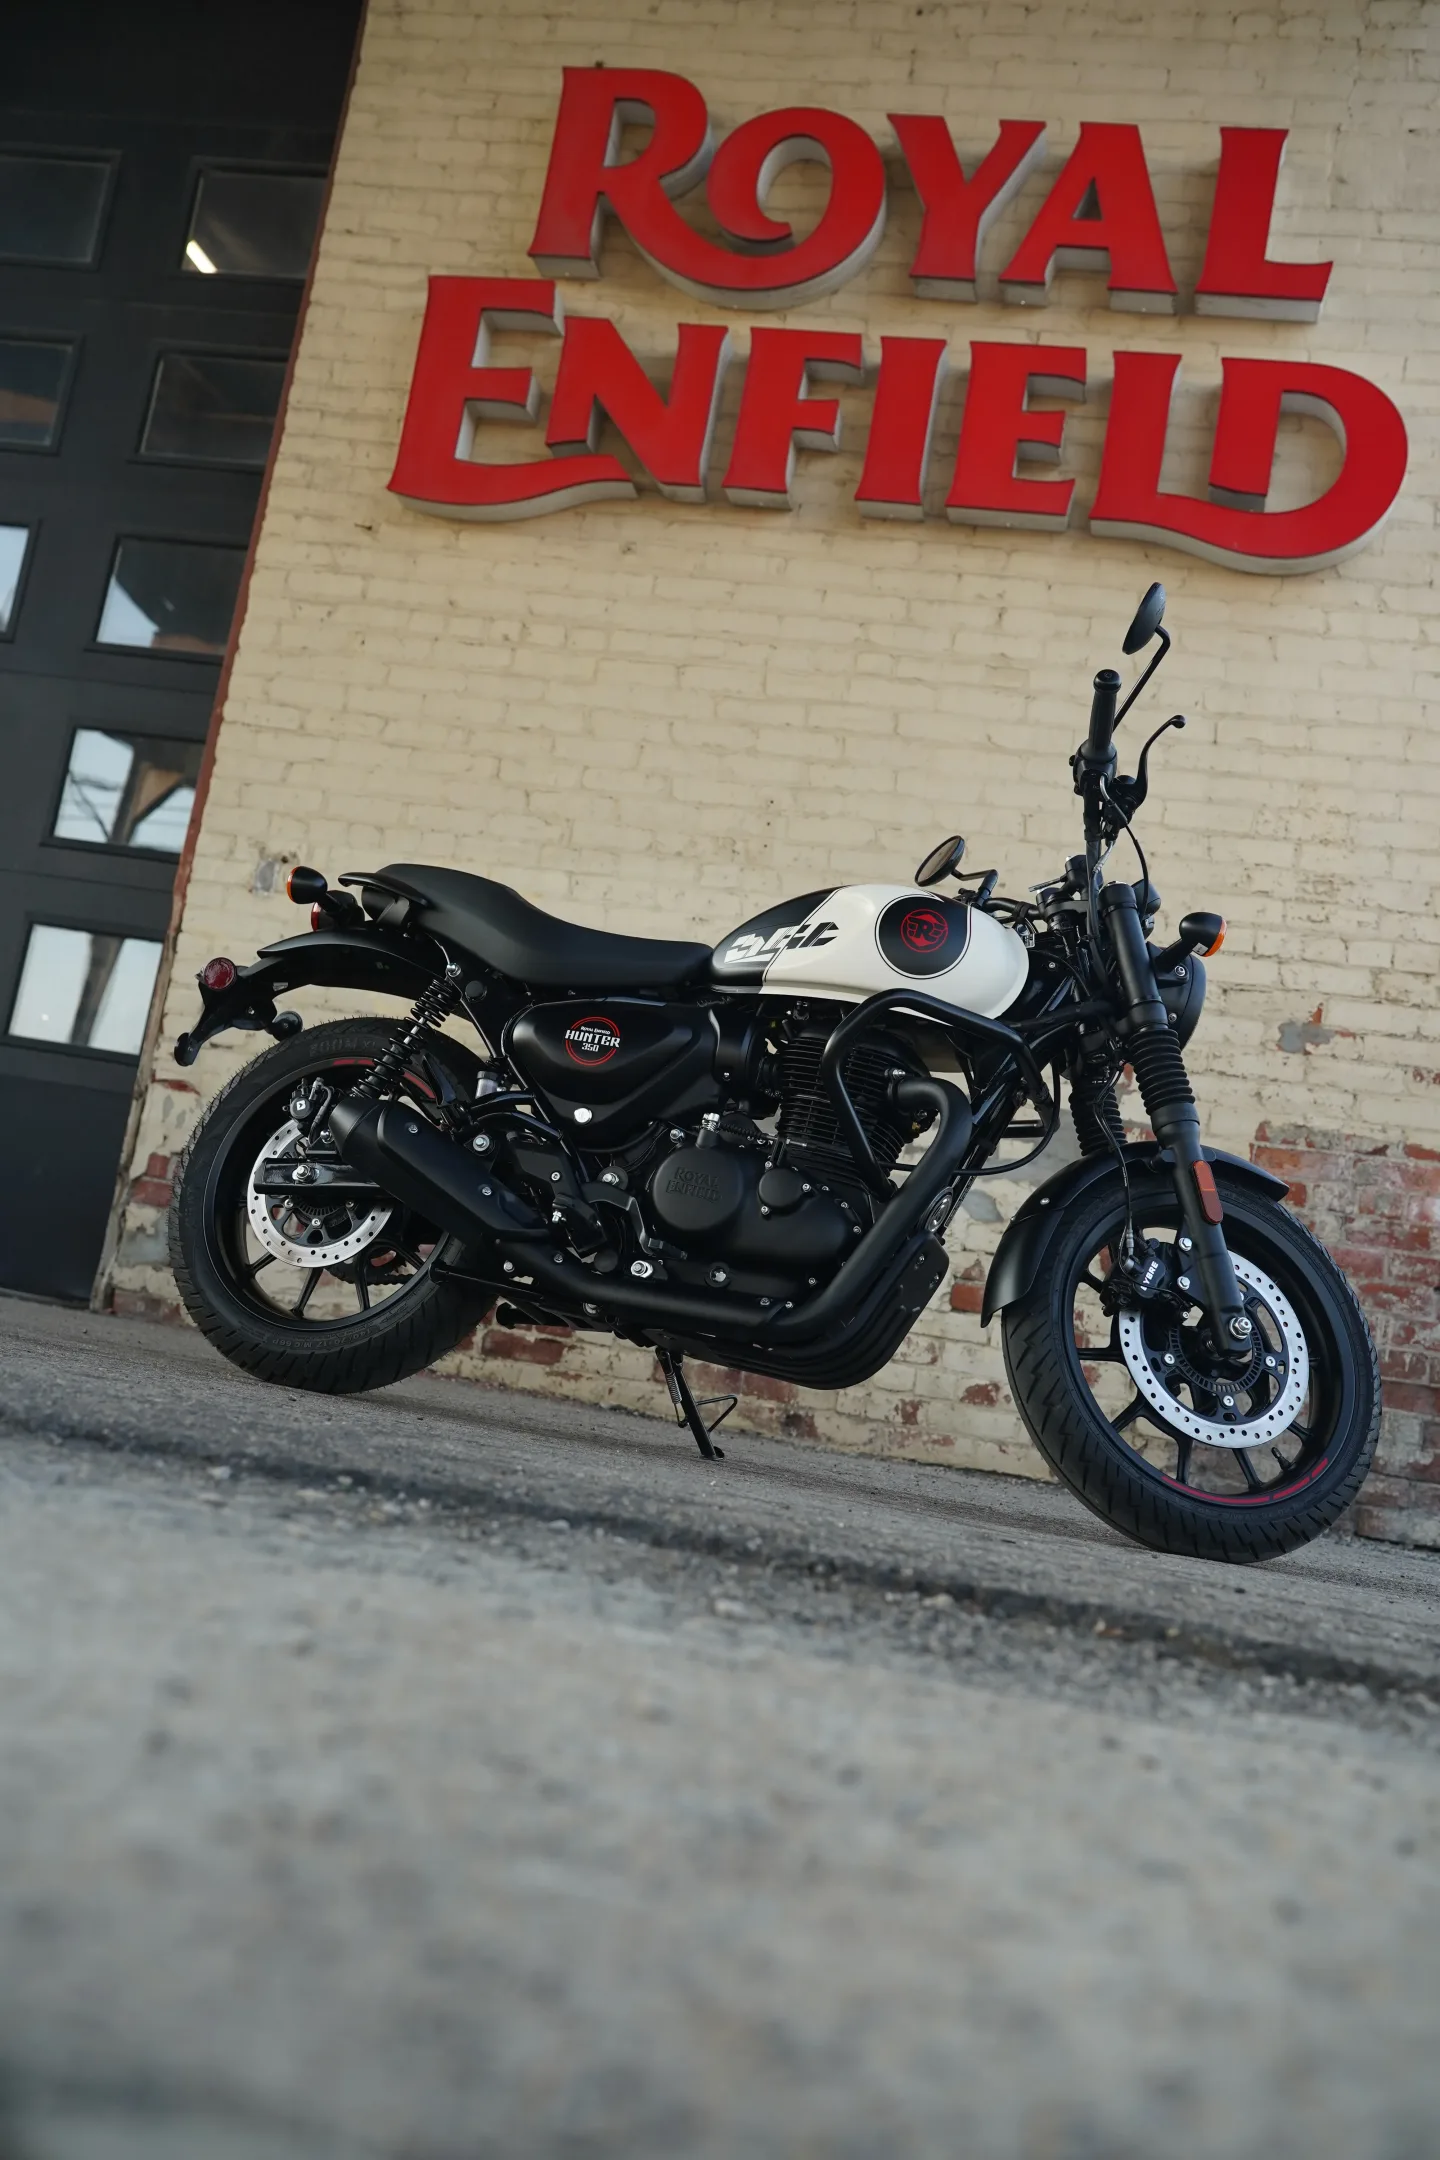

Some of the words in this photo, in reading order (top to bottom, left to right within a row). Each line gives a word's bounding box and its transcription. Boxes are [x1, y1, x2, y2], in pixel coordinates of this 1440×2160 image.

[528, 66, 1334, 318] ROYAL
[388, 275, 1409, 570] ENFIELD
[565, 1029, 621, 1048] HUNTER
[582, 1042, 599, 1052] 350
[674, 1166, 722, 1189] ROYAL
